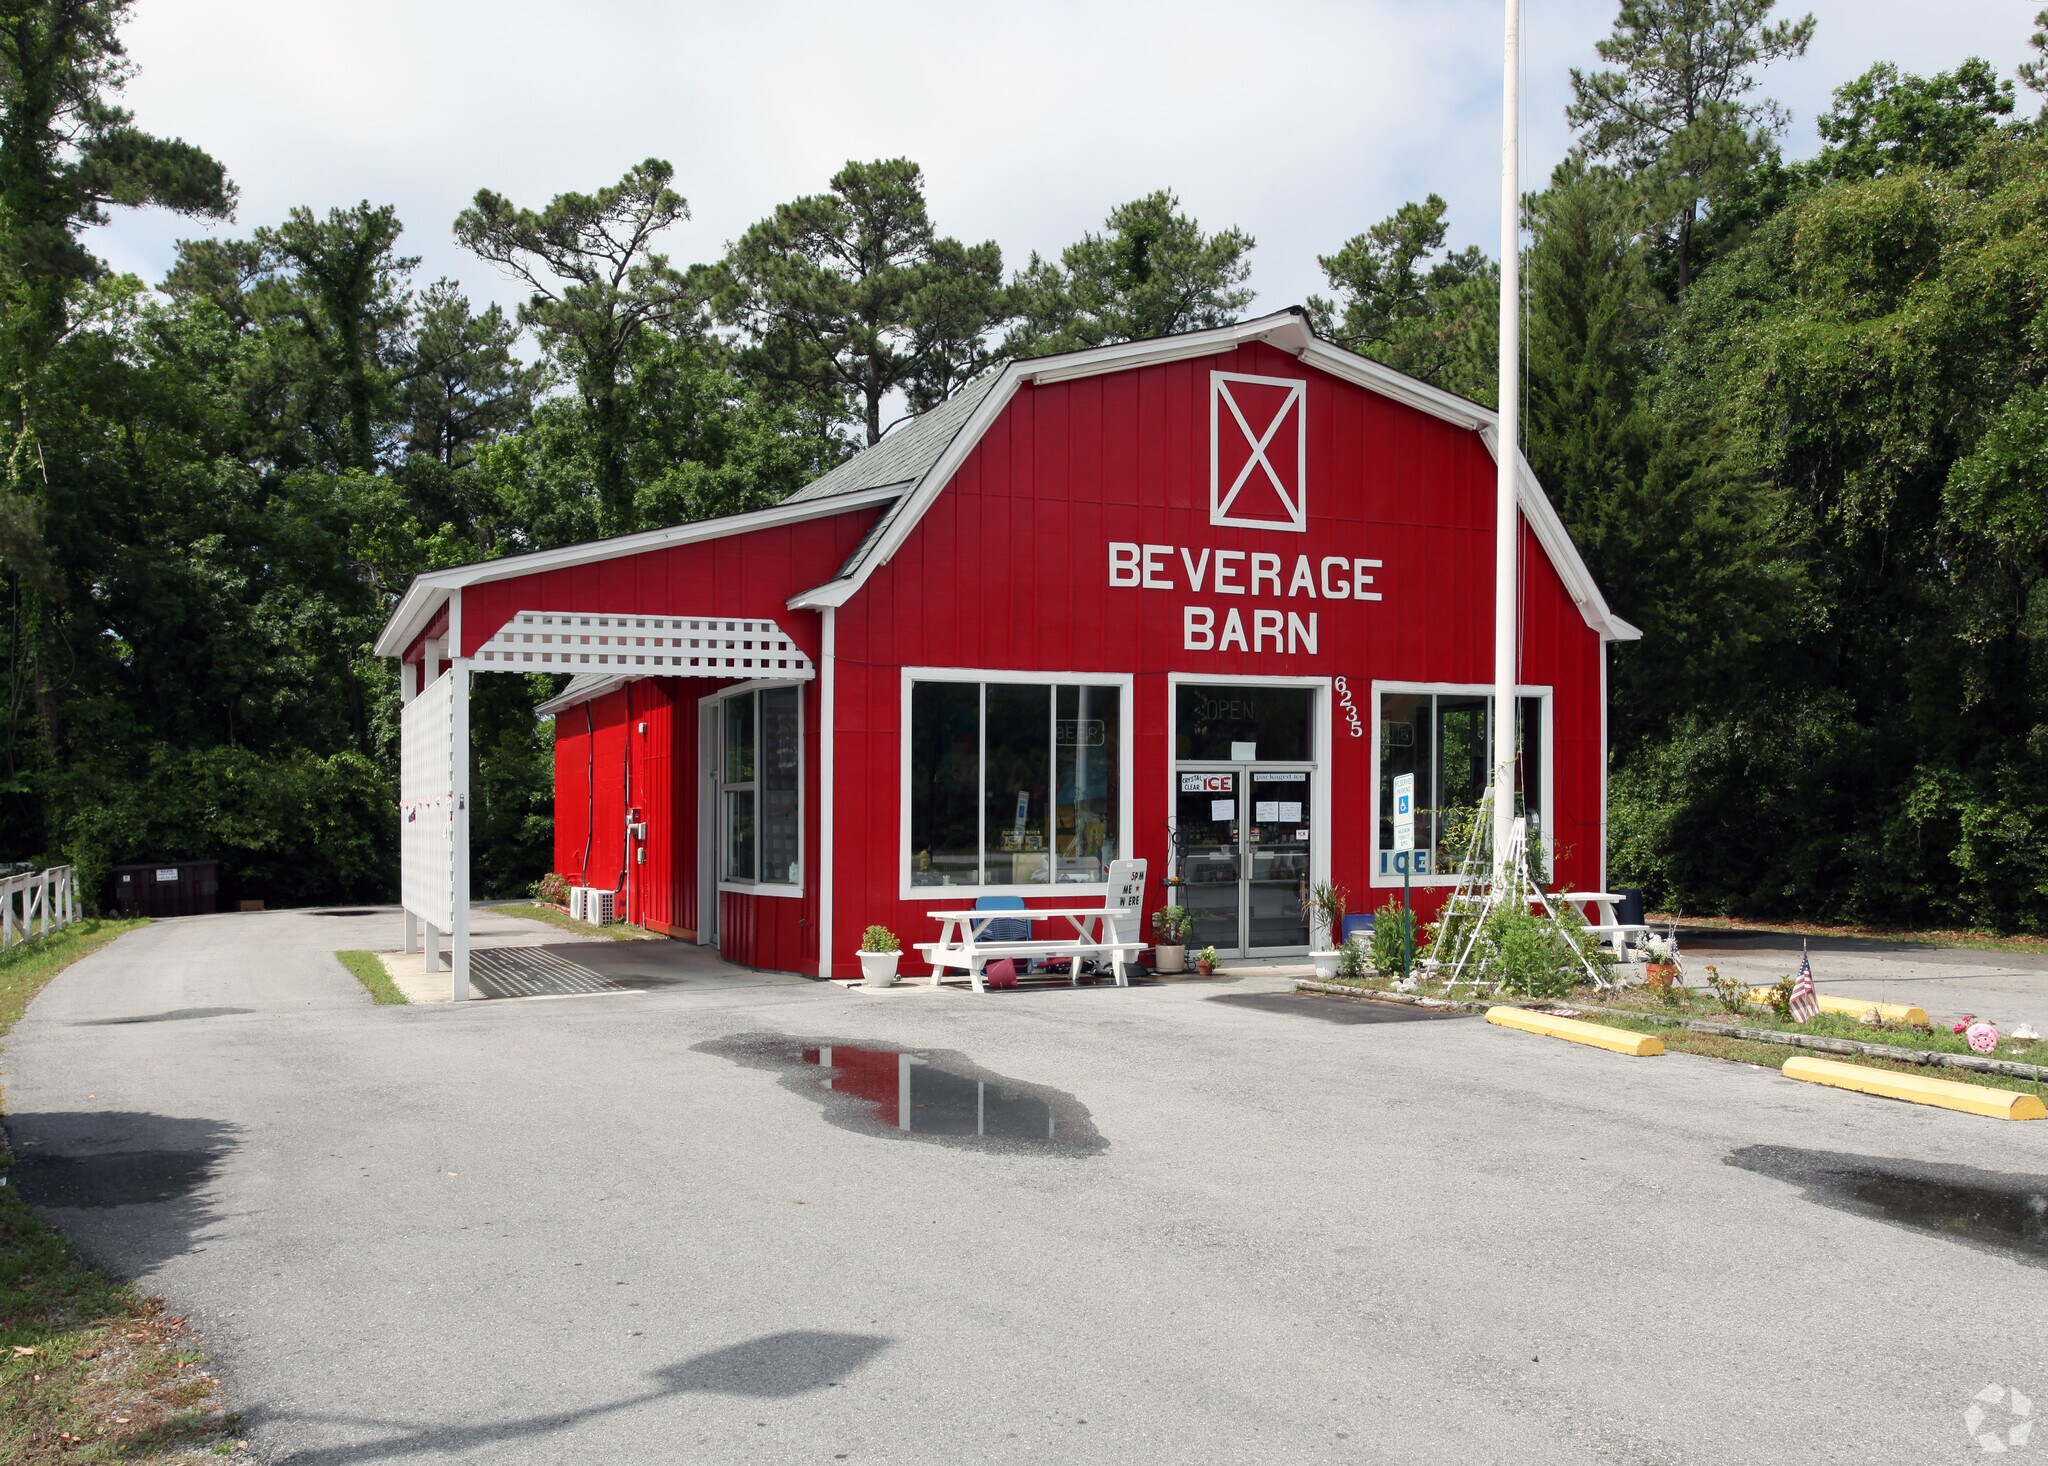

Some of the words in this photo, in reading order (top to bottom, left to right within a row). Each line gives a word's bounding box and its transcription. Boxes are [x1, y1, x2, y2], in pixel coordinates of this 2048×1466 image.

[1109, 542, 1382, 601] BEVERAGE
[1184, 606, 1318, 655] BARN
[1207, 700, 1254, 720] OPEN
[1335, 676, 1363, 737] 6235
[1056, 726, 1099, 740] BEER
[1203, 776, 1231, 790] ICE
[1122, 884, 1132, 894] ME
